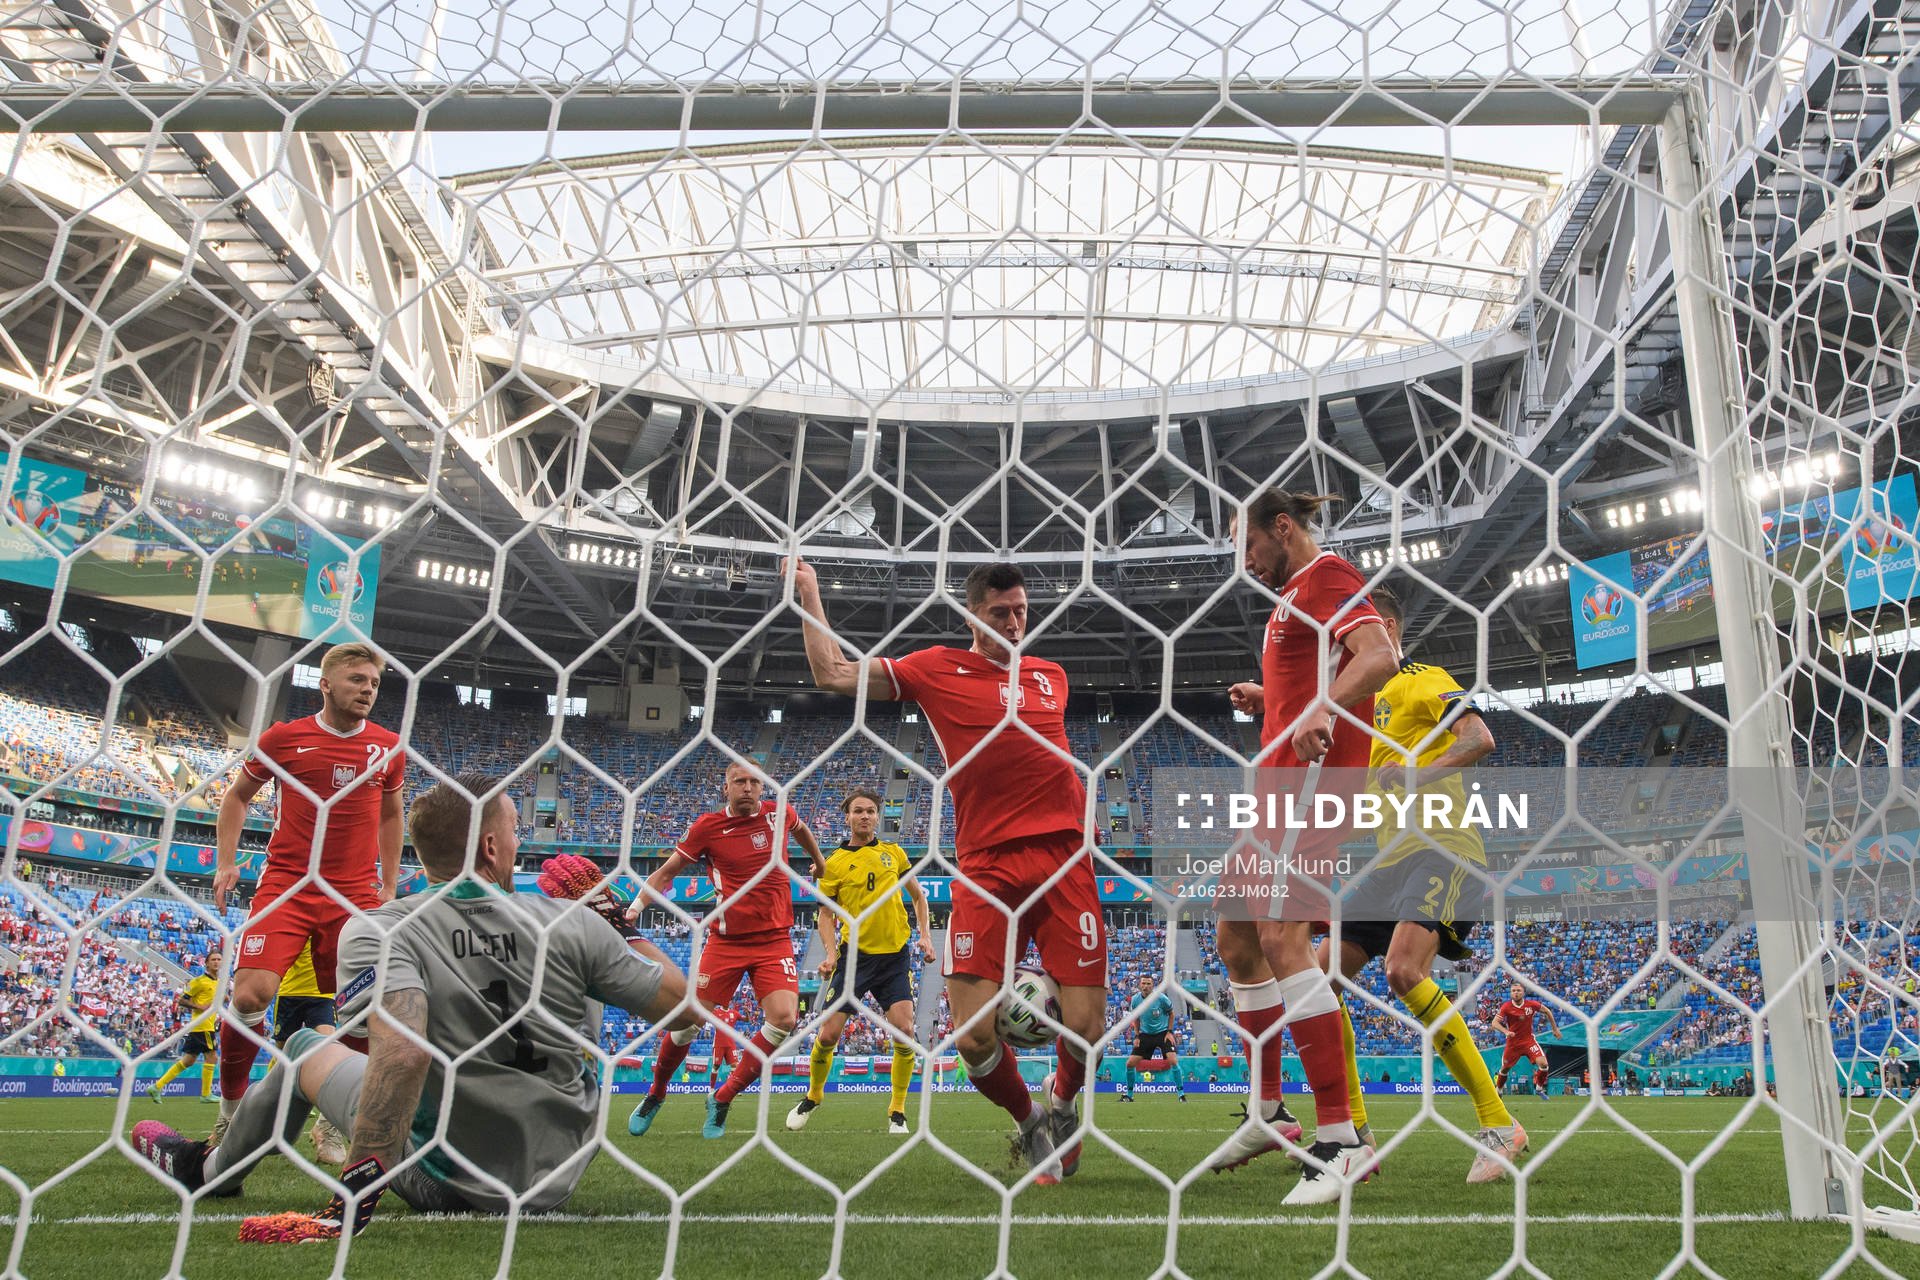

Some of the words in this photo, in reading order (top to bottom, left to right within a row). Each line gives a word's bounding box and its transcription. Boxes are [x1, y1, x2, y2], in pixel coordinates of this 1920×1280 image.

[98, 483, 125, 497] 16:41
[153, 497, 174, 509] SWE
[211, 511, 231, 522] POL
[1640, 549, 1662, 561] 16:41
[311, 603, 365, 622] EURO20
[1582, 624, 1630, 642] EURO2020
[366, 743, 389, 774] 21
[866, 871, 876, 891] 8
[1424, 876, 1444, 907] 2
[1079, 911, 1098, 950] 9
[780, 957, 797, 976] 15
[346, 970, 375, 998] RESPECT
[479, 979, 549, 1073] 1
[52, 1078, 113, 1095] Booking.com
[745, 1083, 808, 1094] Booing.com
[837, 1083, 892, 1093] Booking.co
[1116, 1083, 1178, 1094] Boking.com
[1209, 1083, 1251, 1094] Booking.
[1395, 1083, 1460, 1094] Booki.com
